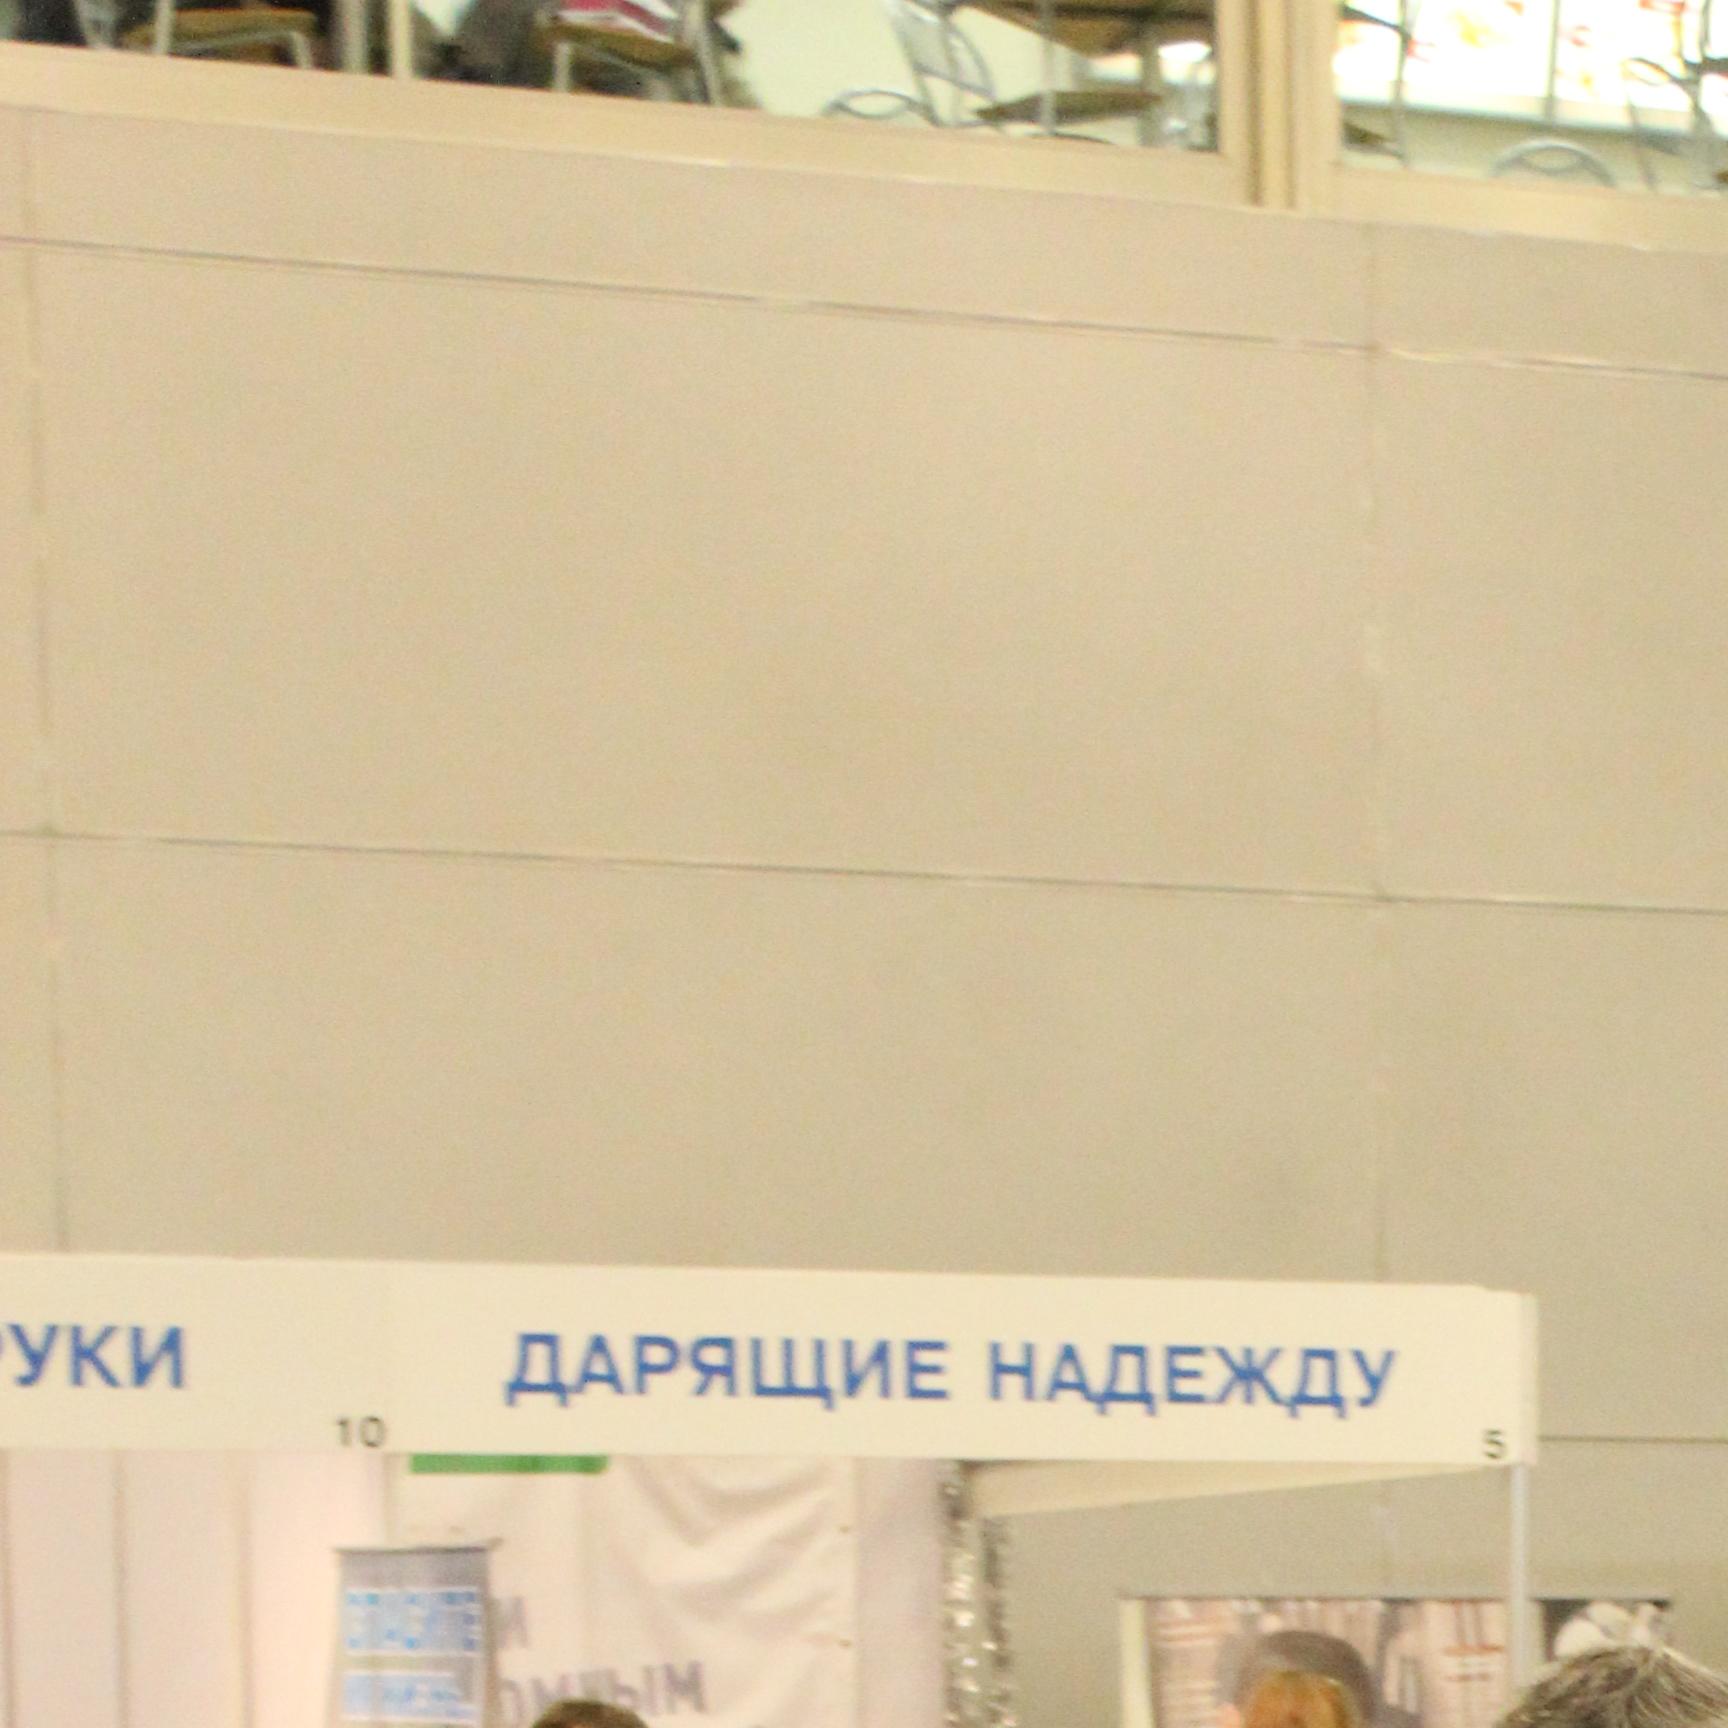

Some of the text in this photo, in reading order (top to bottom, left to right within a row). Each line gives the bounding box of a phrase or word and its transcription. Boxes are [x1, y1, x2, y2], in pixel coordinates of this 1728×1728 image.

[0, 1322, 184, 1389] УКИ
[504, 1332, 1400, 1418] ДАРЯЩИЕ НАДЕЖДУ
[337, 1415, 387, 1448] 10
[1483, 1428, 1508, 1461] 5
